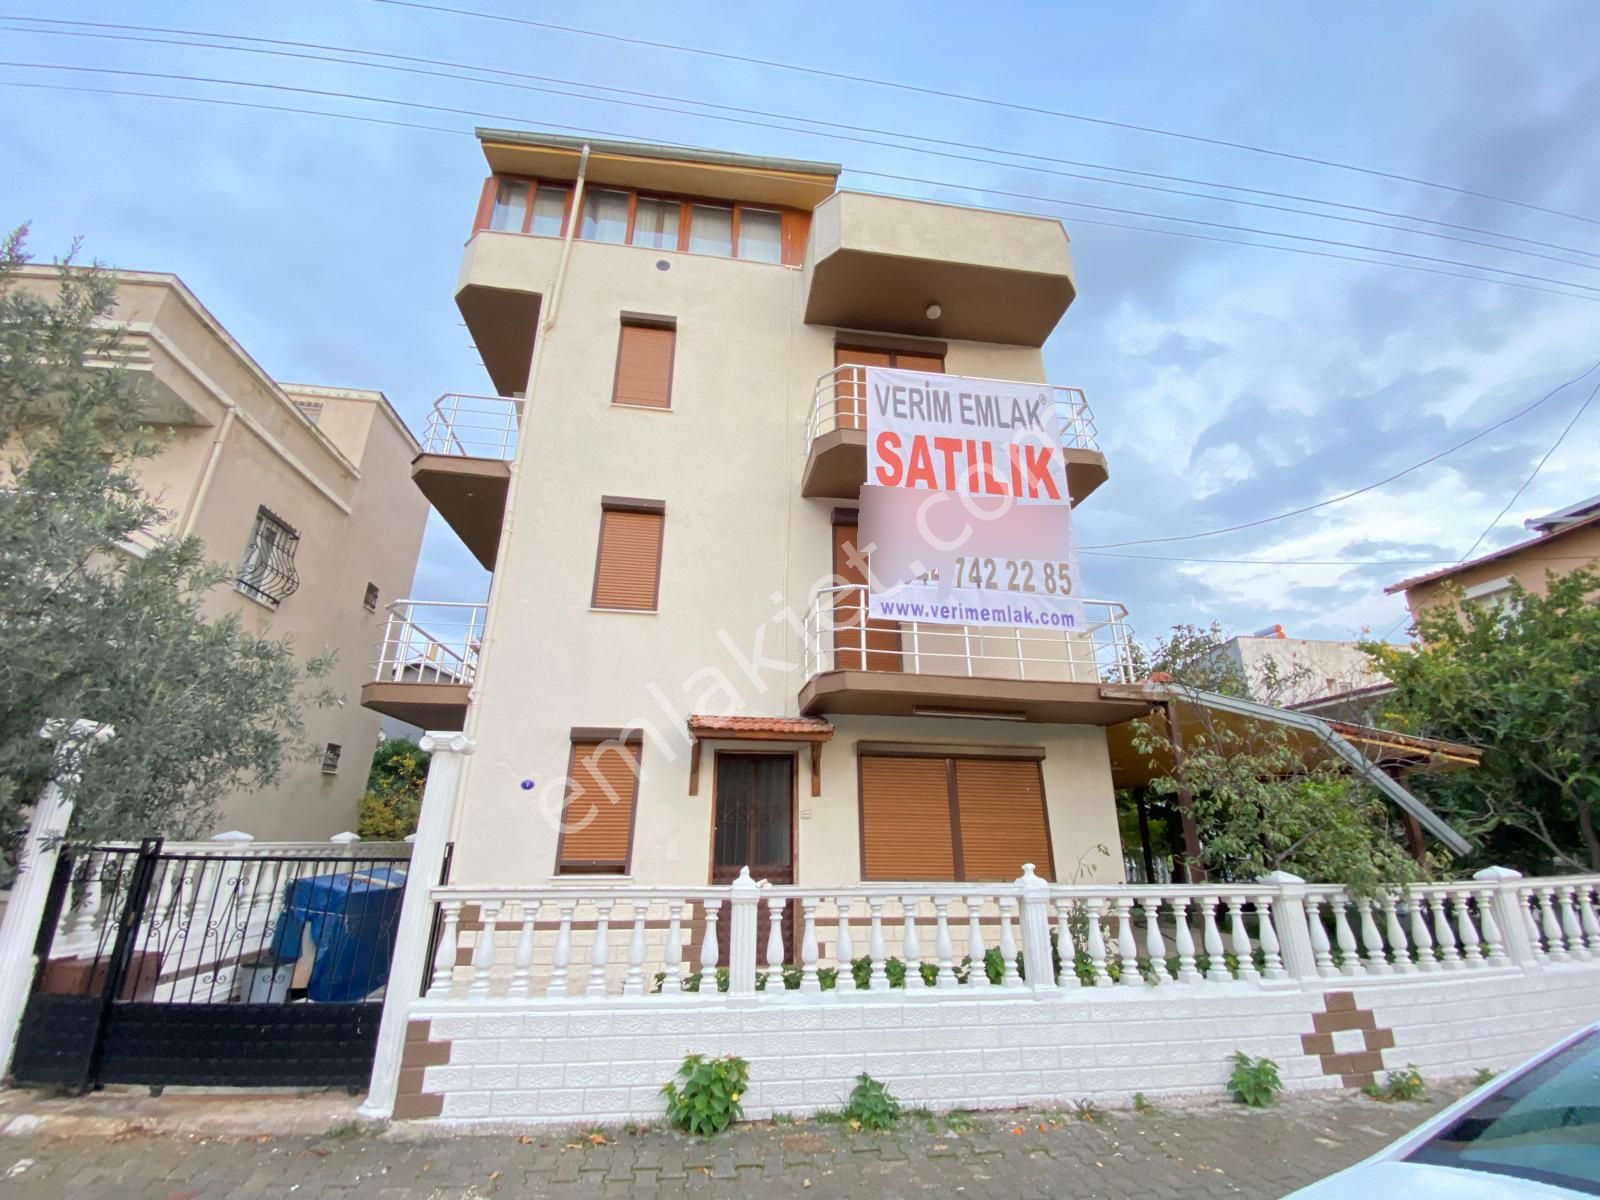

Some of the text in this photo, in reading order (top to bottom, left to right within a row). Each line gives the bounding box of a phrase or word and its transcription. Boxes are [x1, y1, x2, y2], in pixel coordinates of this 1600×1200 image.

[874, 380, 952, 424] VERİM
[875, 431, 1061, 500] SATILIK
[955, 557, 998, 590] 742
[1006, 560, 1036, 593] 22
[1043, 561, 1073, 596] 85
[880, 600, 1076, 628] www.verimemlak.com
